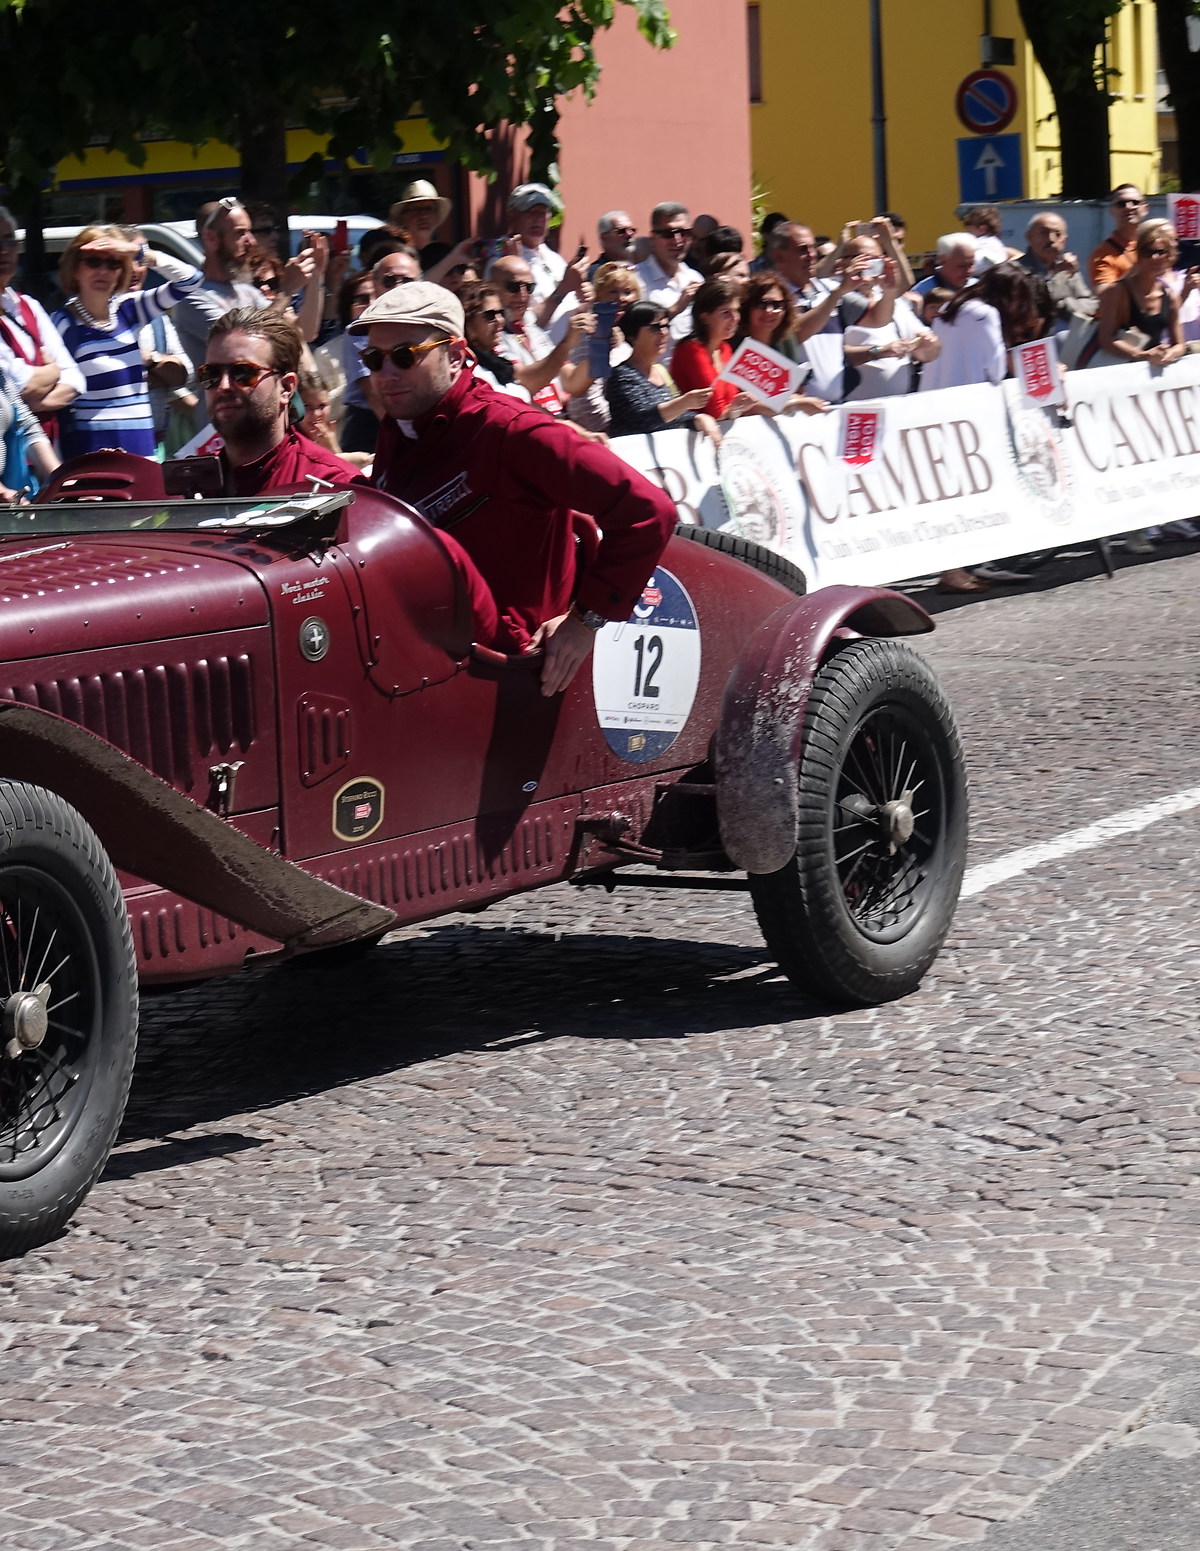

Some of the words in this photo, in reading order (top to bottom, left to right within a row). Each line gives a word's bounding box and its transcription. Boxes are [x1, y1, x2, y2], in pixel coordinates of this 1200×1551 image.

[743, 352, 783, 378] 1000
[1035, 351, 1050, 386] 1000
[859, 419, 876, 457] 1000
[1071, 384, 1200, 473] CAME
[633, 634, 664, 698] 12
